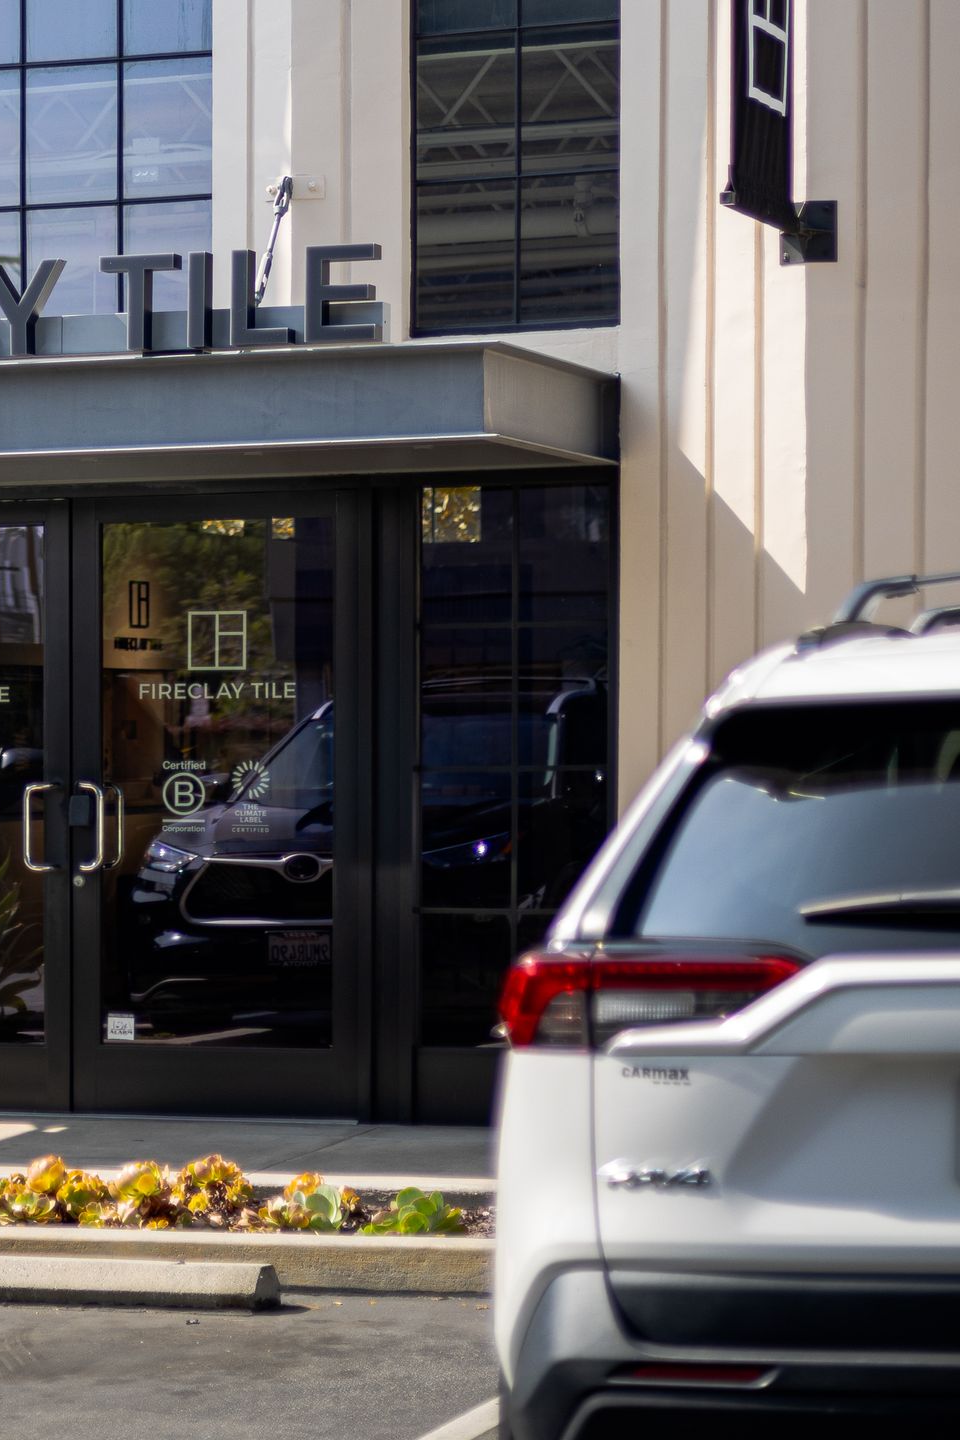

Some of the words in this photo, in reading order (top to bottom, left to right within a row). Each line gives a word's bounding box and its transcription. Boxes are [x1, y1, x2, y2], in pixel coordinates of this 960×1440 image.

[99, 242, 382, 353] TILE
[138, 682, 245, 700] FIRECLAY
[251, 682, 297, 699] TILE
[162, 760, 206, 770] Certified
[162, 825, 206, 833] Corporation
